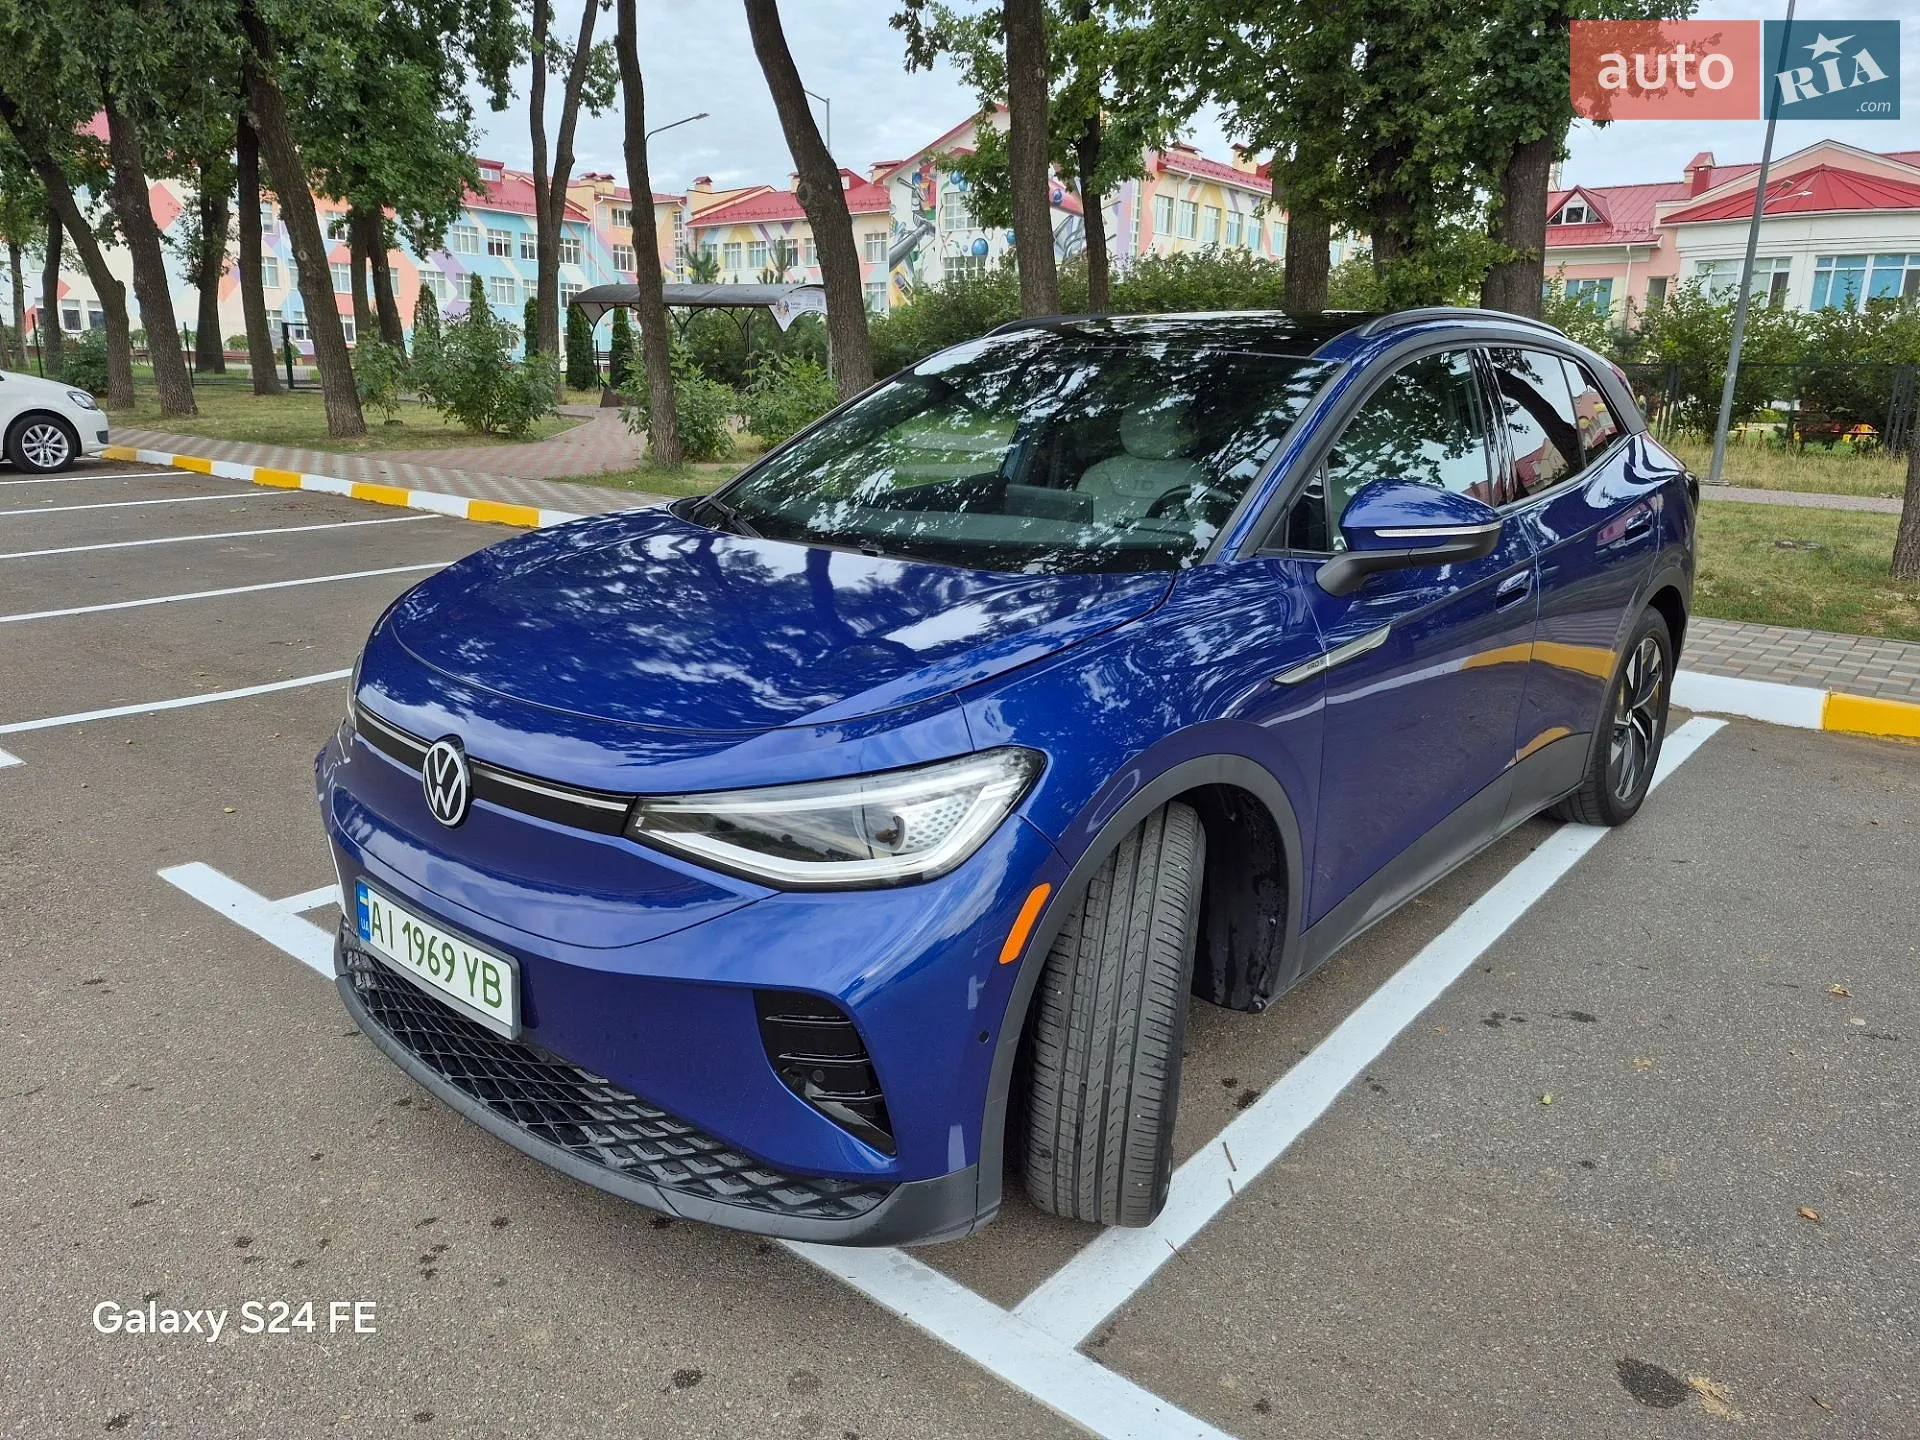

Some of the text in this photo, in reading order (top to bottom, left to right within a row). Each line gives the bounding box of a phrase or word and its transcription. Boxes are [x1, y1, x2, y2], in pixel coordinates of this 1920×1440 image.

[423, 741, 466, 826] VW
[371, 901, 502, 1009] AI 1969 YB
